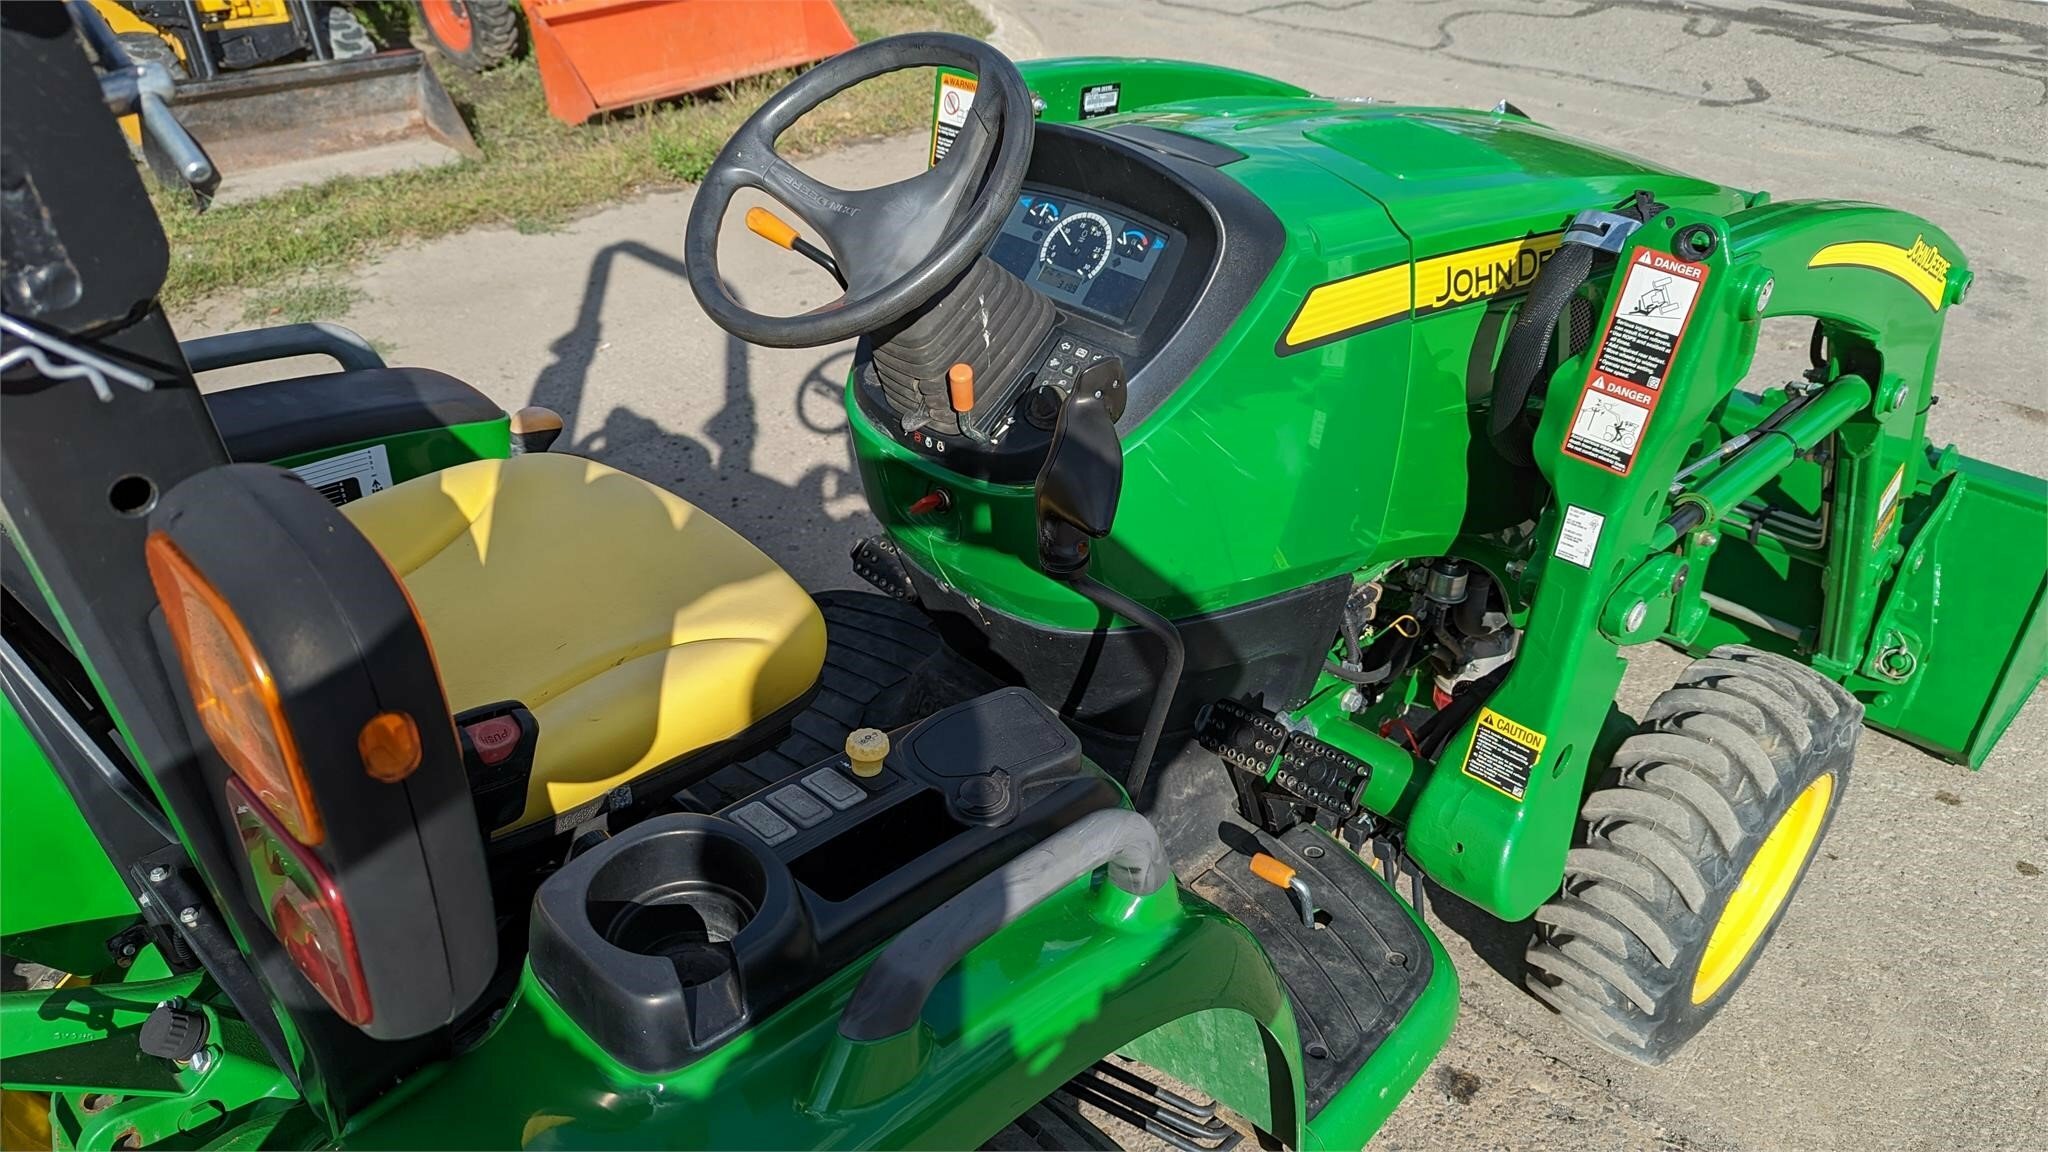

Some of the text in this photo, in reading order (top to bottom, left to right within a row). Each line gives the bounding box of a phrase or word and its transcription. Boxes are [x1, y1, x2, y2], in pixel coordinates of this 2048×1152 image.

[783, 175, 828, 208] DEERE
[1654, 257, 1702, 279] DANGER
[1436, 259, 1513, 303] JOHN
[1607, 383, 1652, 404] DANGER
[479, 729, 508, 745] PUSH
[1496, 719, 1542, 748] CAUTION
